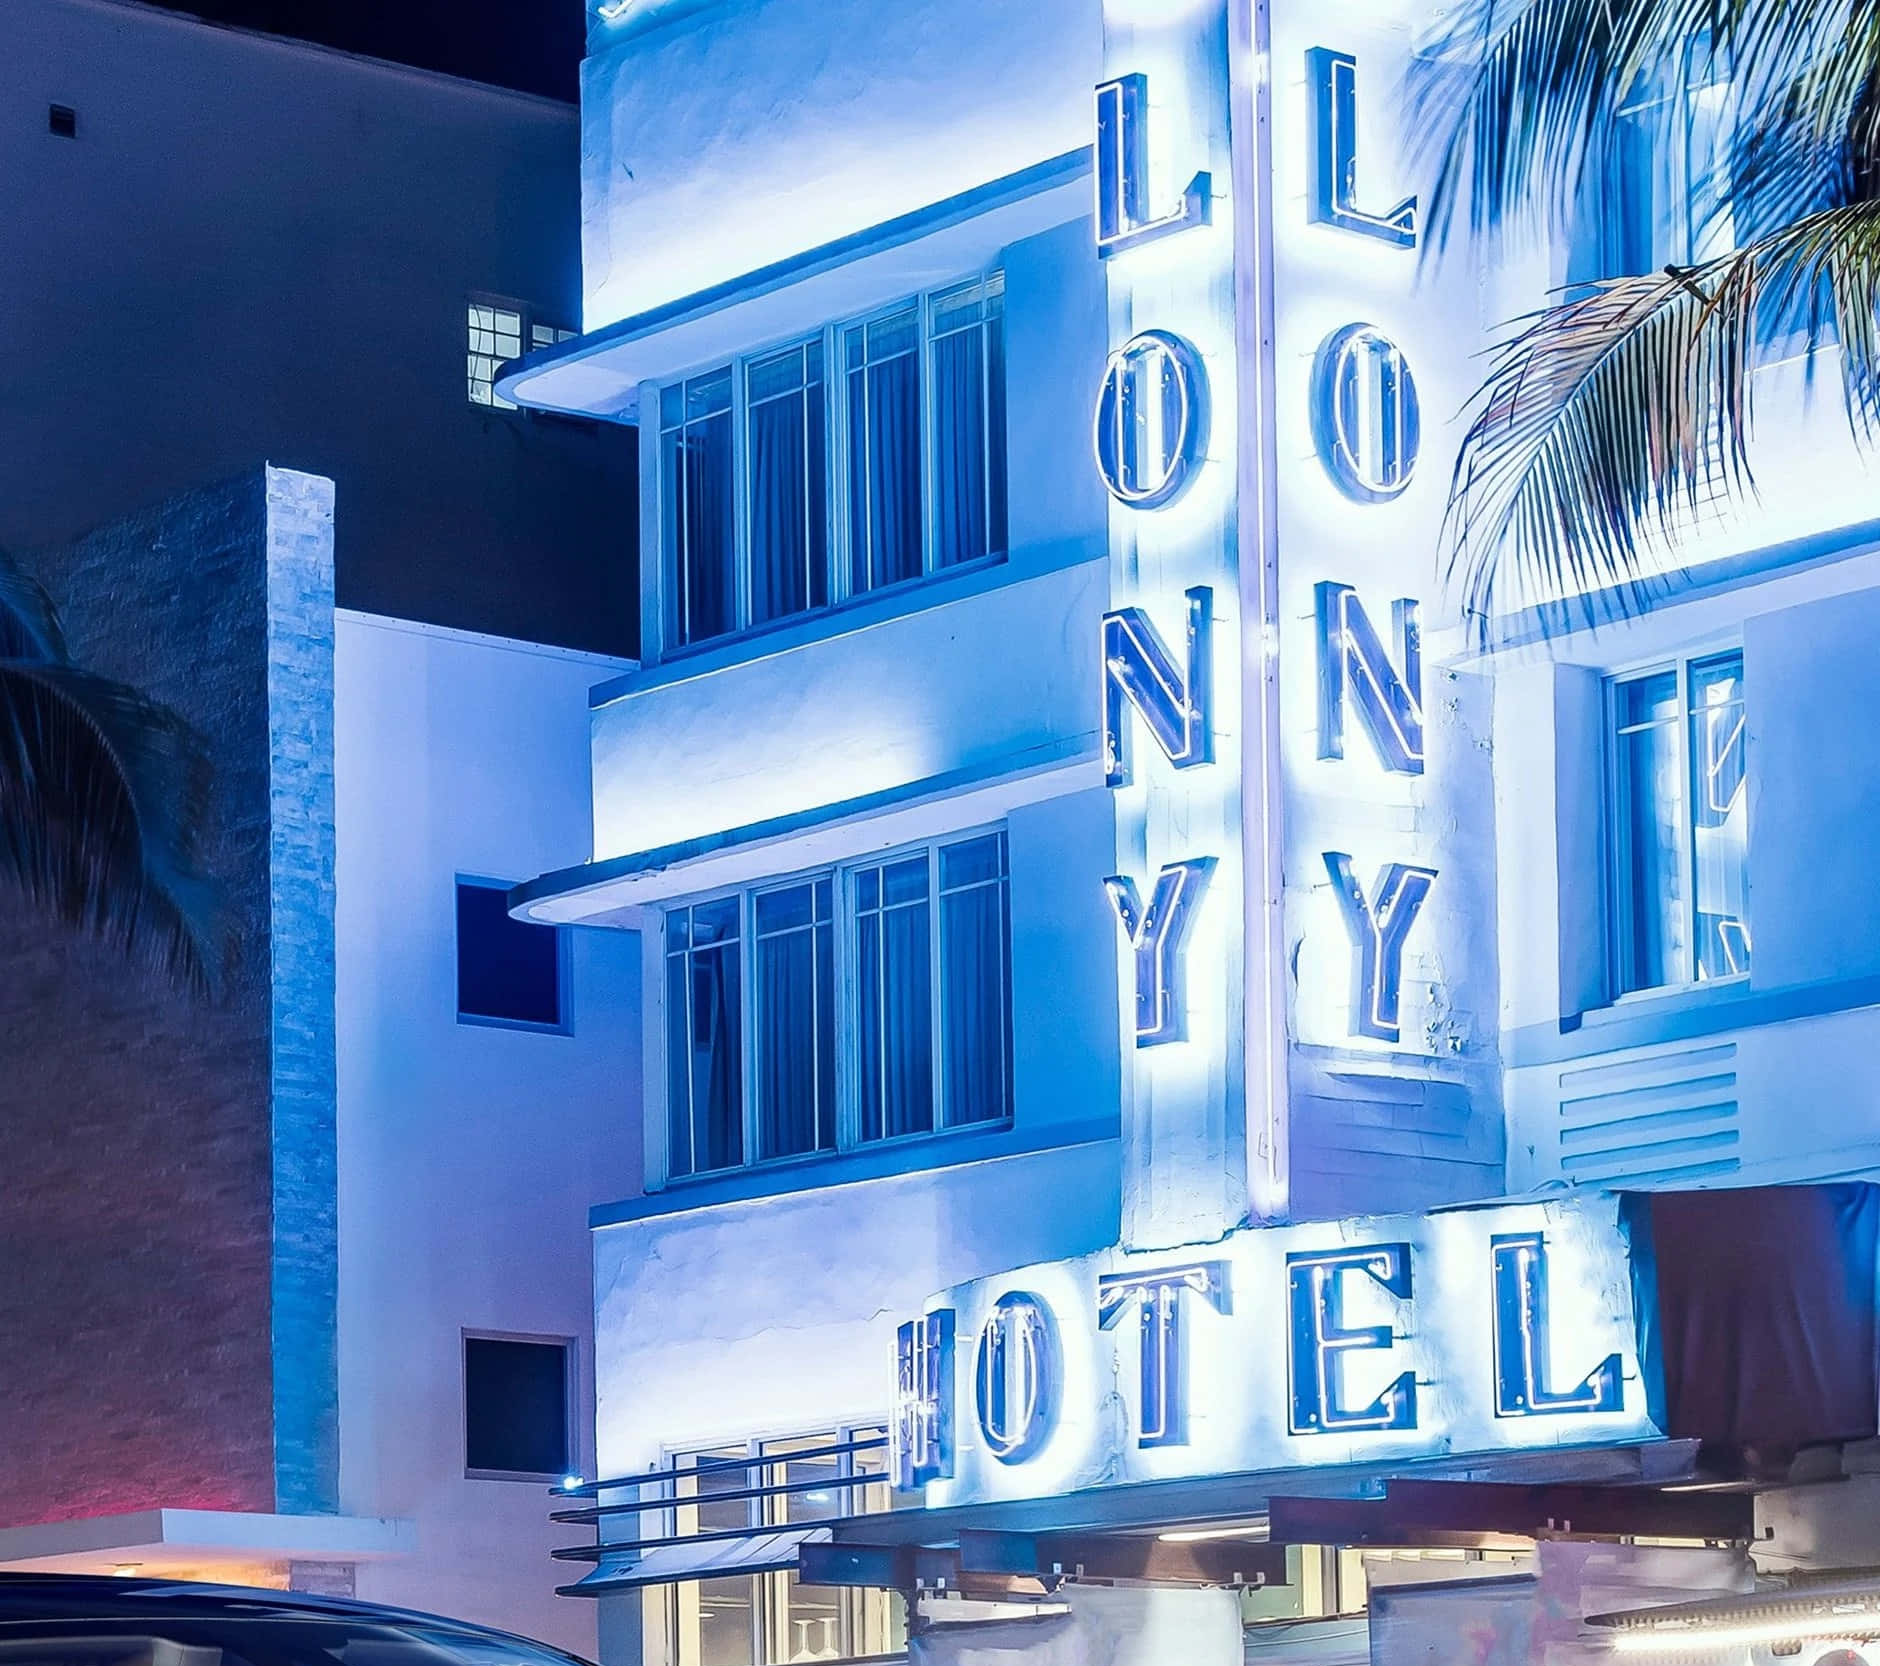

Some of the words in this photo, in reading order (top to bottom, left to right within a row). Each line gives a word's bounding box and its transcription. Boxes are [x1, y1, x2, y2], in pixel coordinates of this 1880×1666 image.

[1093, 72, 1219, 1049] LONY
[1304, 46, 1439, 1043] LONY
[888, 1231, 1625, 1492] HOTEL
